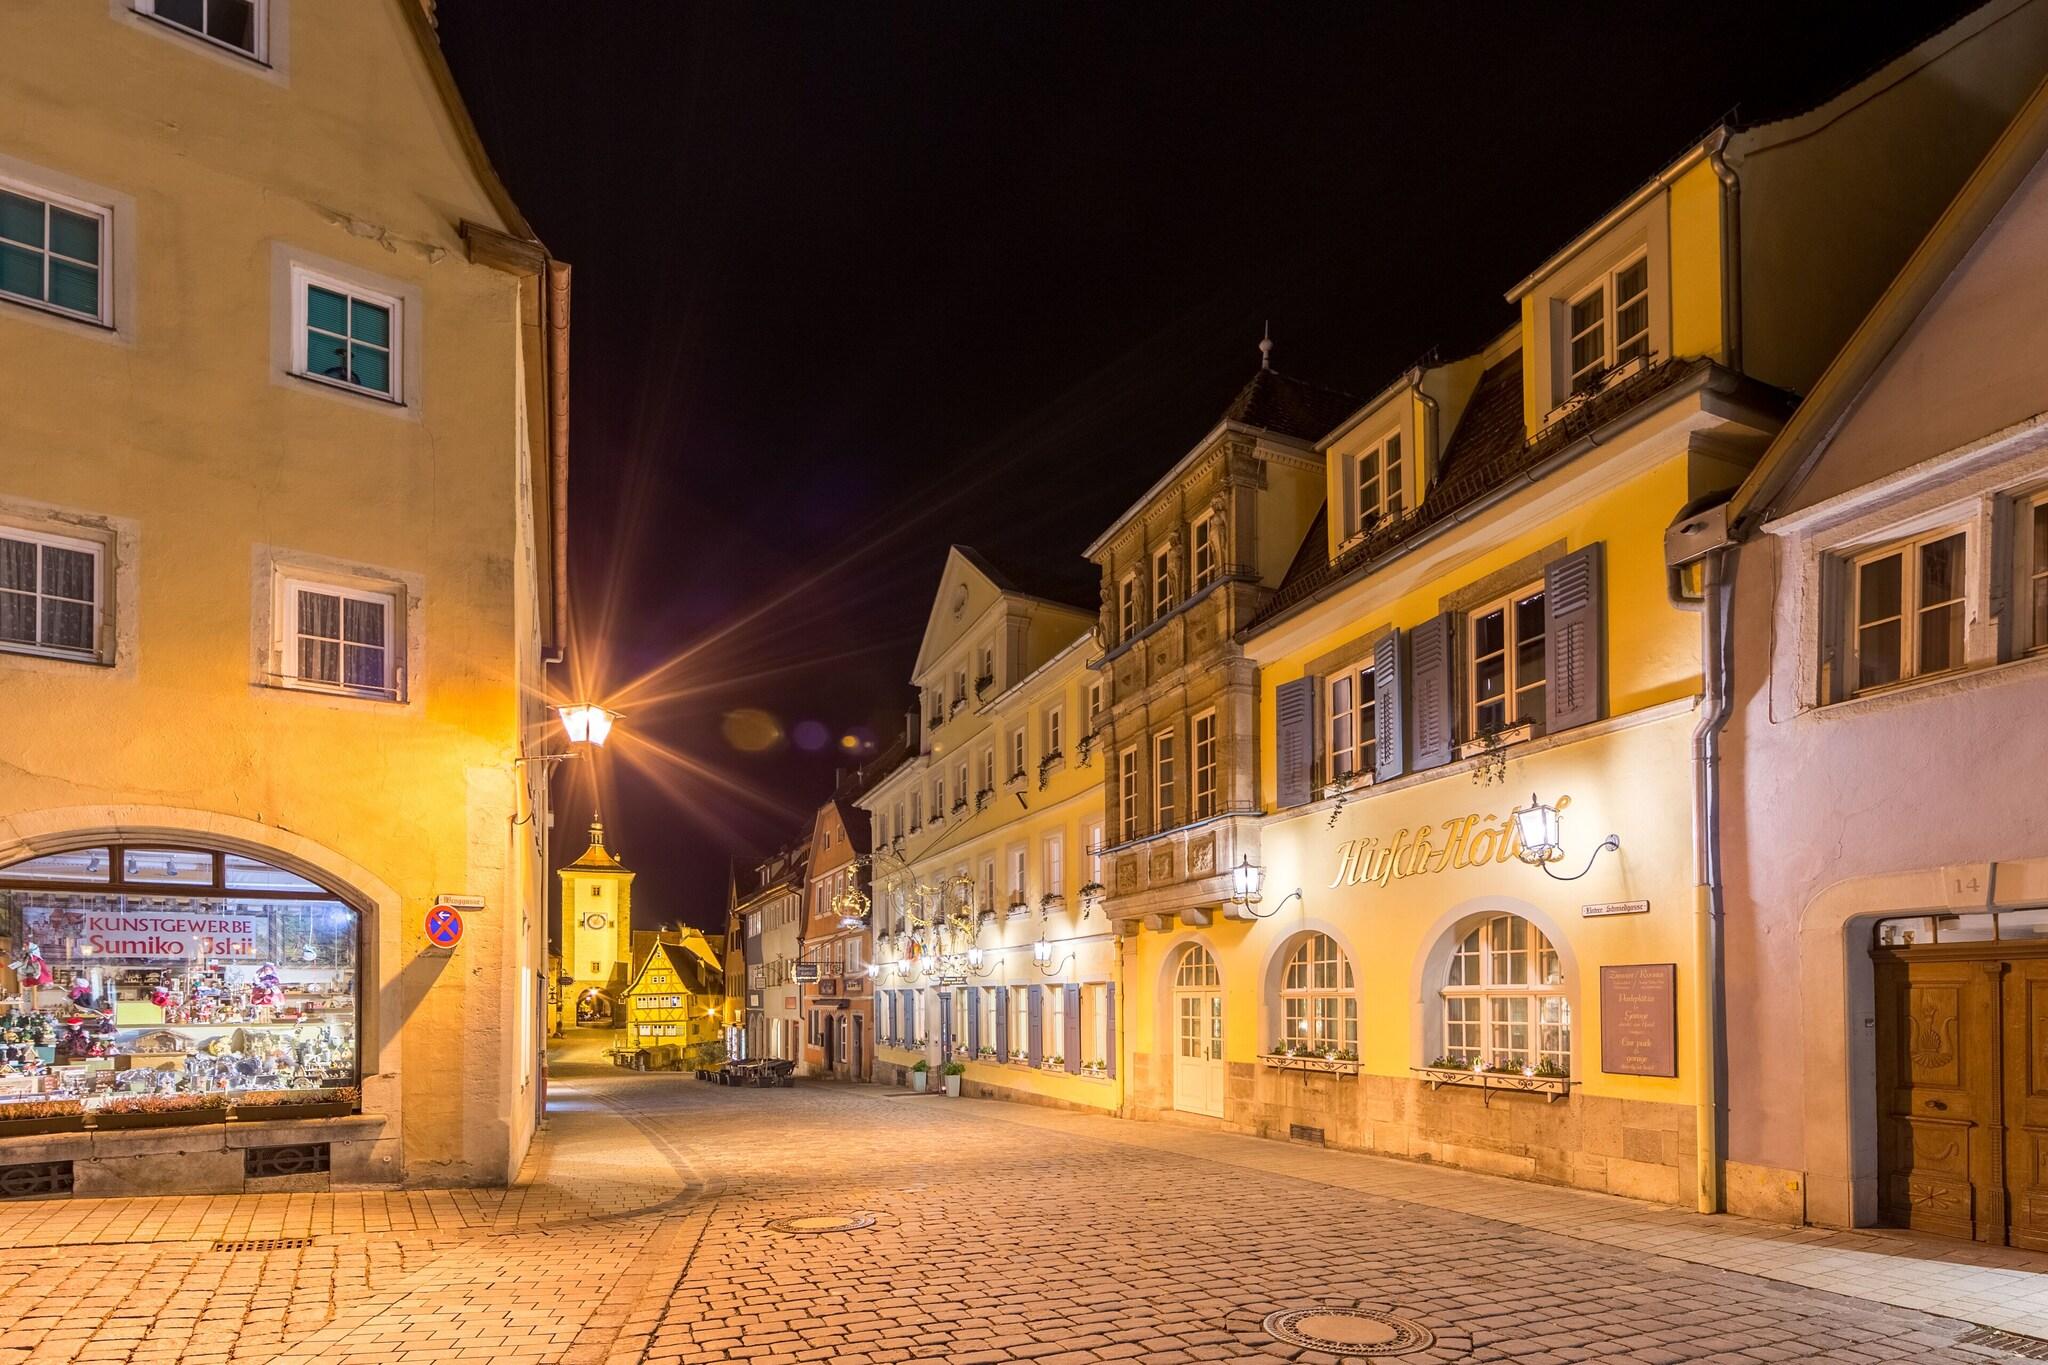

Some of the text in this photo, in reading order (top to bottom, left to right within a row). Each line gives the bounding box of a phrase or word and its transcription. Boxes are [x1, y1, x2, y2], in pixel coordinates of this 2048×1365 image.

[1956, 877, 1981, 893] 14
[89, 917, 251, 933] KUNSTGEWERBE
[89, 934, 184, 955] Sumiko
